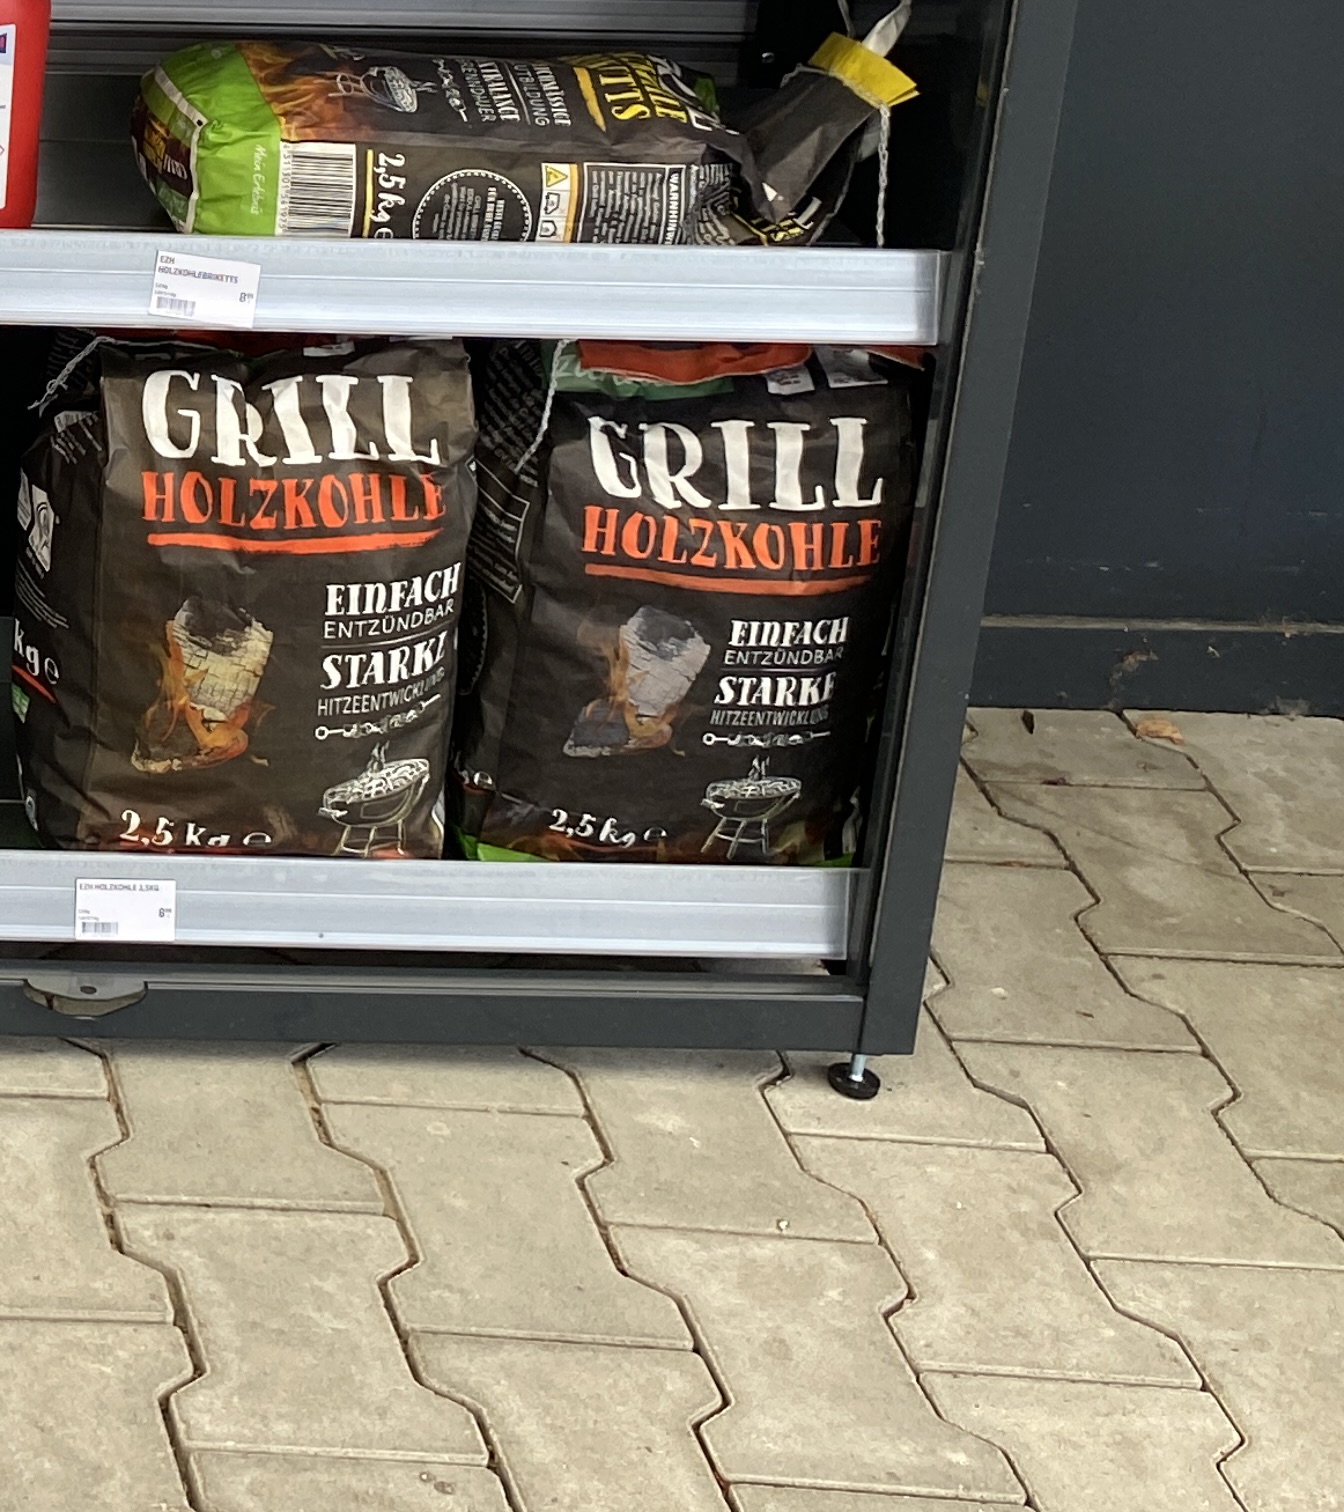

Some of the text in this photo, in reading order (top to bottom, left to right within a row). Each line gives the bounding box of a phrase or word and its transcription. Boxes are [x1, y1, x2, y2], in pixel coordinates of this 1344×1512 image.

[251, 144, 266, 172] Mein
[369, 153, 406, 224] 2,5 kg
[142, 369, 440, 467] GRILL
[588, 416, 884, 511] GRILL
[141, 471, 447, 531] HOLZKOHLE
[582, 505, 882, 571] HOLZKOHLE
[324, 562, 461, 618] EINFACH
[323, 599, 456, 640] ENTZÜNDBAR
[729, 617, 849, 648] EINFACH
[723, 644, 844, 666] ENTZÜNDBAR
[715, 672, 837, 707] STARKE
[119, 810, 175, 847] 2,5
[548, 808, 636, 849] 2,5 kg
